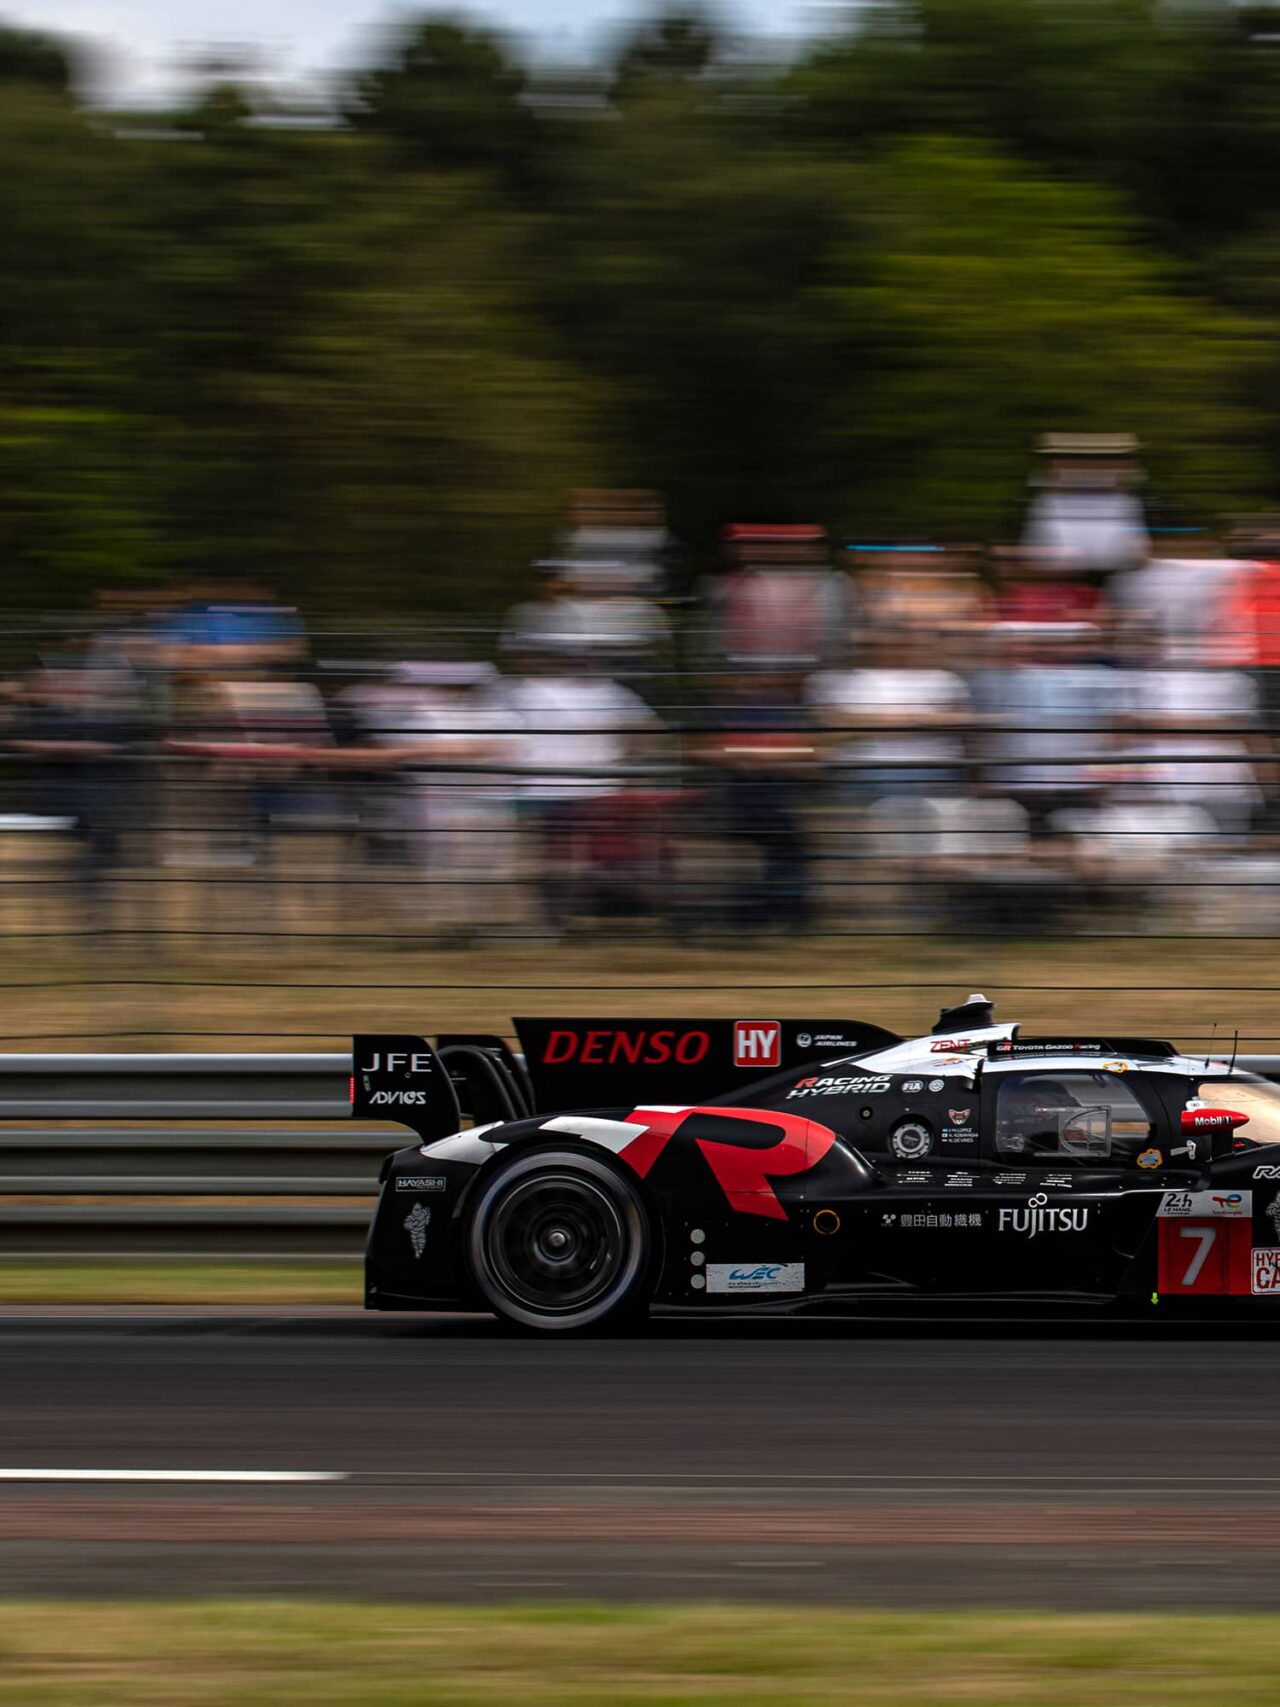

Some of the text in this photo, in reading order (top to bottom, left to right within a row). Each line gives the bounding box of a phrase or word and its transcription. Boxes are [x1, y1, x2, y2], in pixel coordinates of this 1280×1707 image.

[542, 1030, 710, 1065] DENSO
[738, 1029, 777, 1059] HY
[929, 1039, 971, 1053] ZENT
[361, 1053, 432, 1072] JFE
[785, 1082, 891, 1100] HYBRID
[903, 1081, 921, 1091] FIA
[1195, 1117, 1222, 1126] Mobil
[398, 1179, 444, 1187] HAYASHI
[998, 1206, 1089, 1239] FUJITSU
[1180, 1226, 1217, 1286] 7
[729, 1266, 783, 1280] WEC
